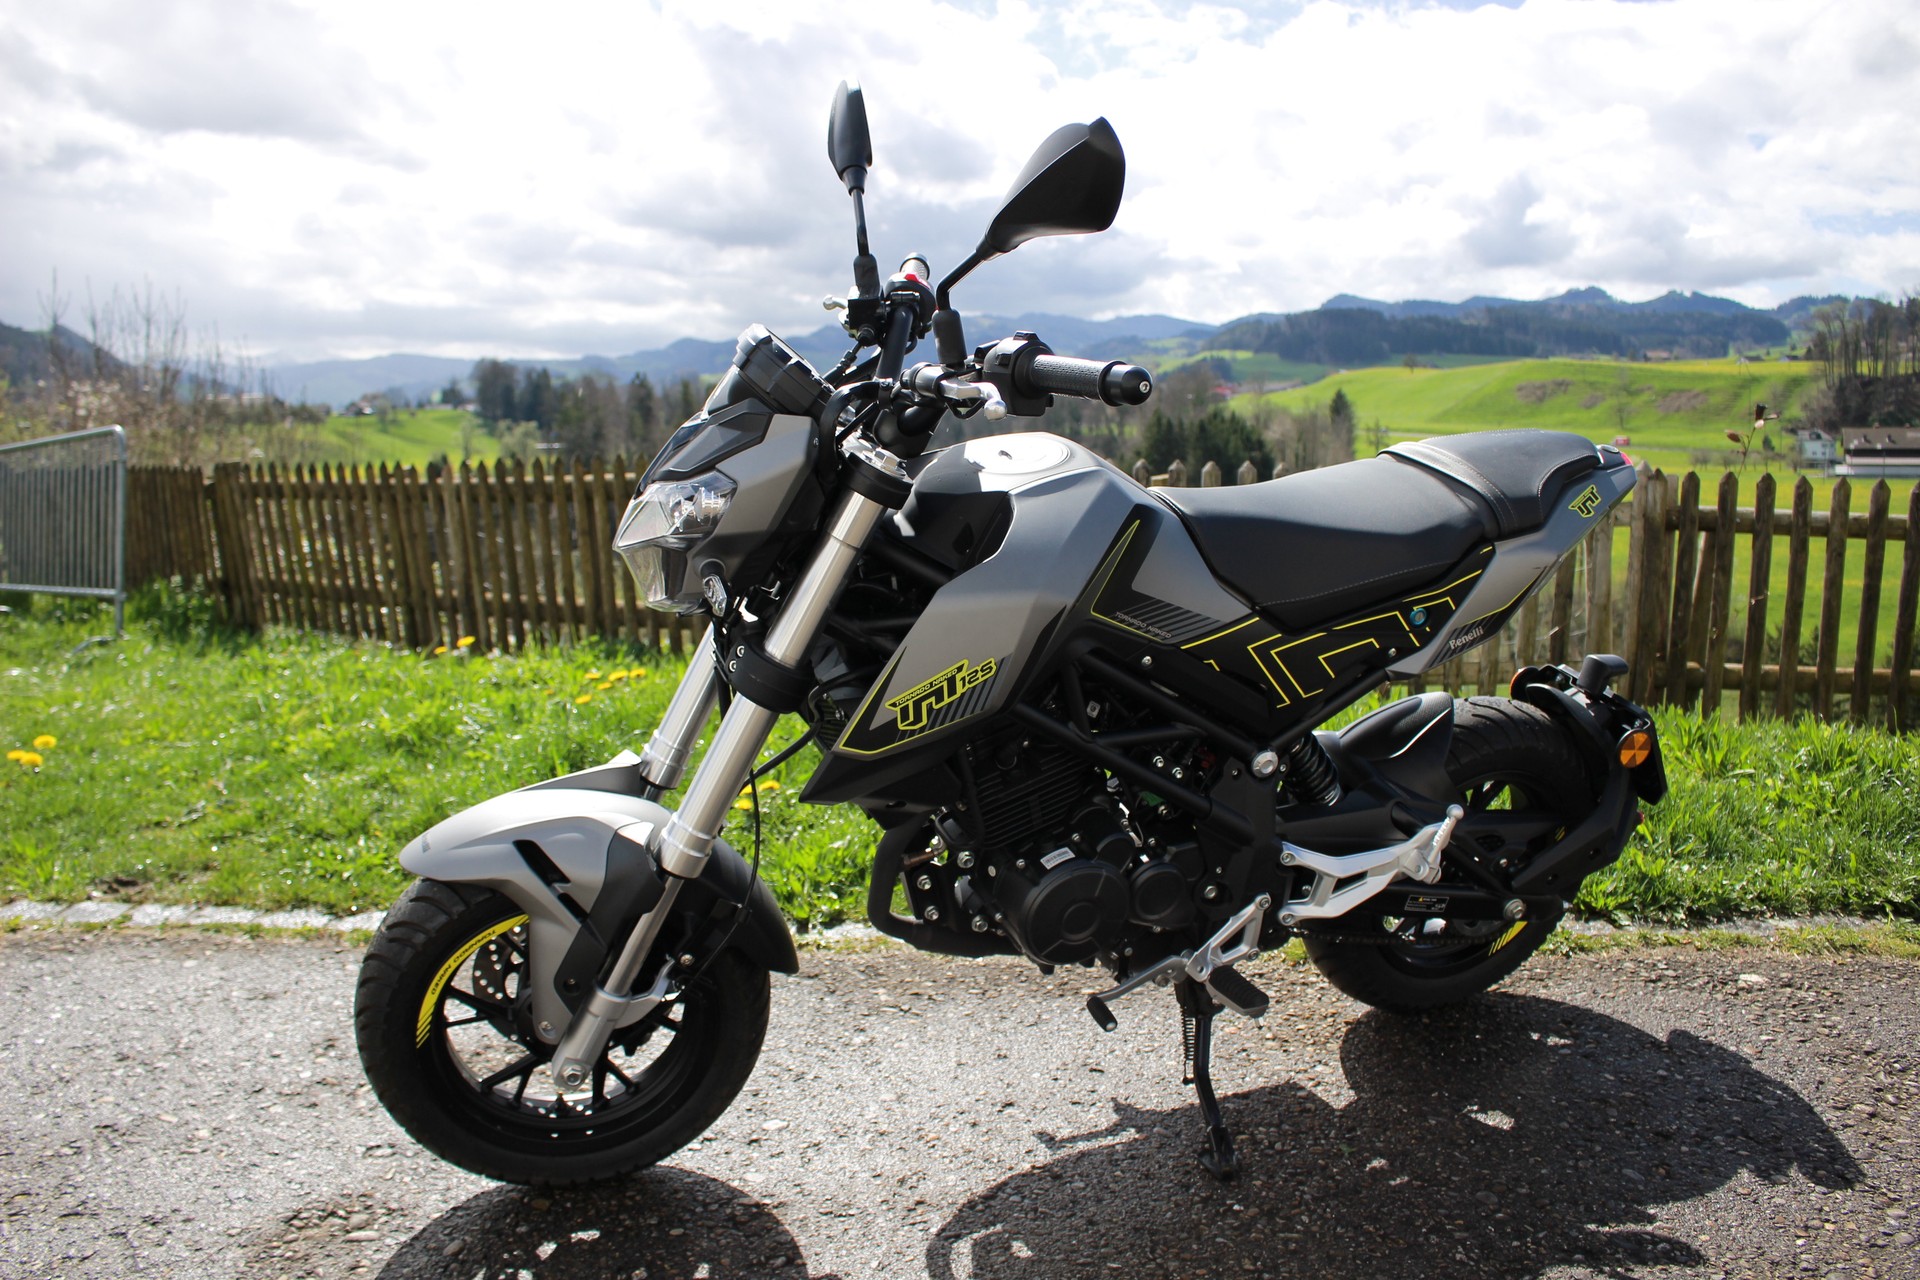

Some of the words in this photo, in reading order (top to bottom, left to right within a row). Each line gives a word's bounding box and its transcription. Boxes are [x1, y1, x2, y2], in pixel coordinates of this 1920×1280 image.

[1115, 611, 1147, 628] TORNADO
[1147, 626, 1172, 639] NAKED
[1448, 626, 1484, 650] Benelli
[895, 684, 931, 706] TORNADO
[932, 668, 958, 687] NAKED
[959, 659, 995, 691] 125
[453, 930, 497, 963] TORNADO
[431, 964, 452, 995] NAKED
